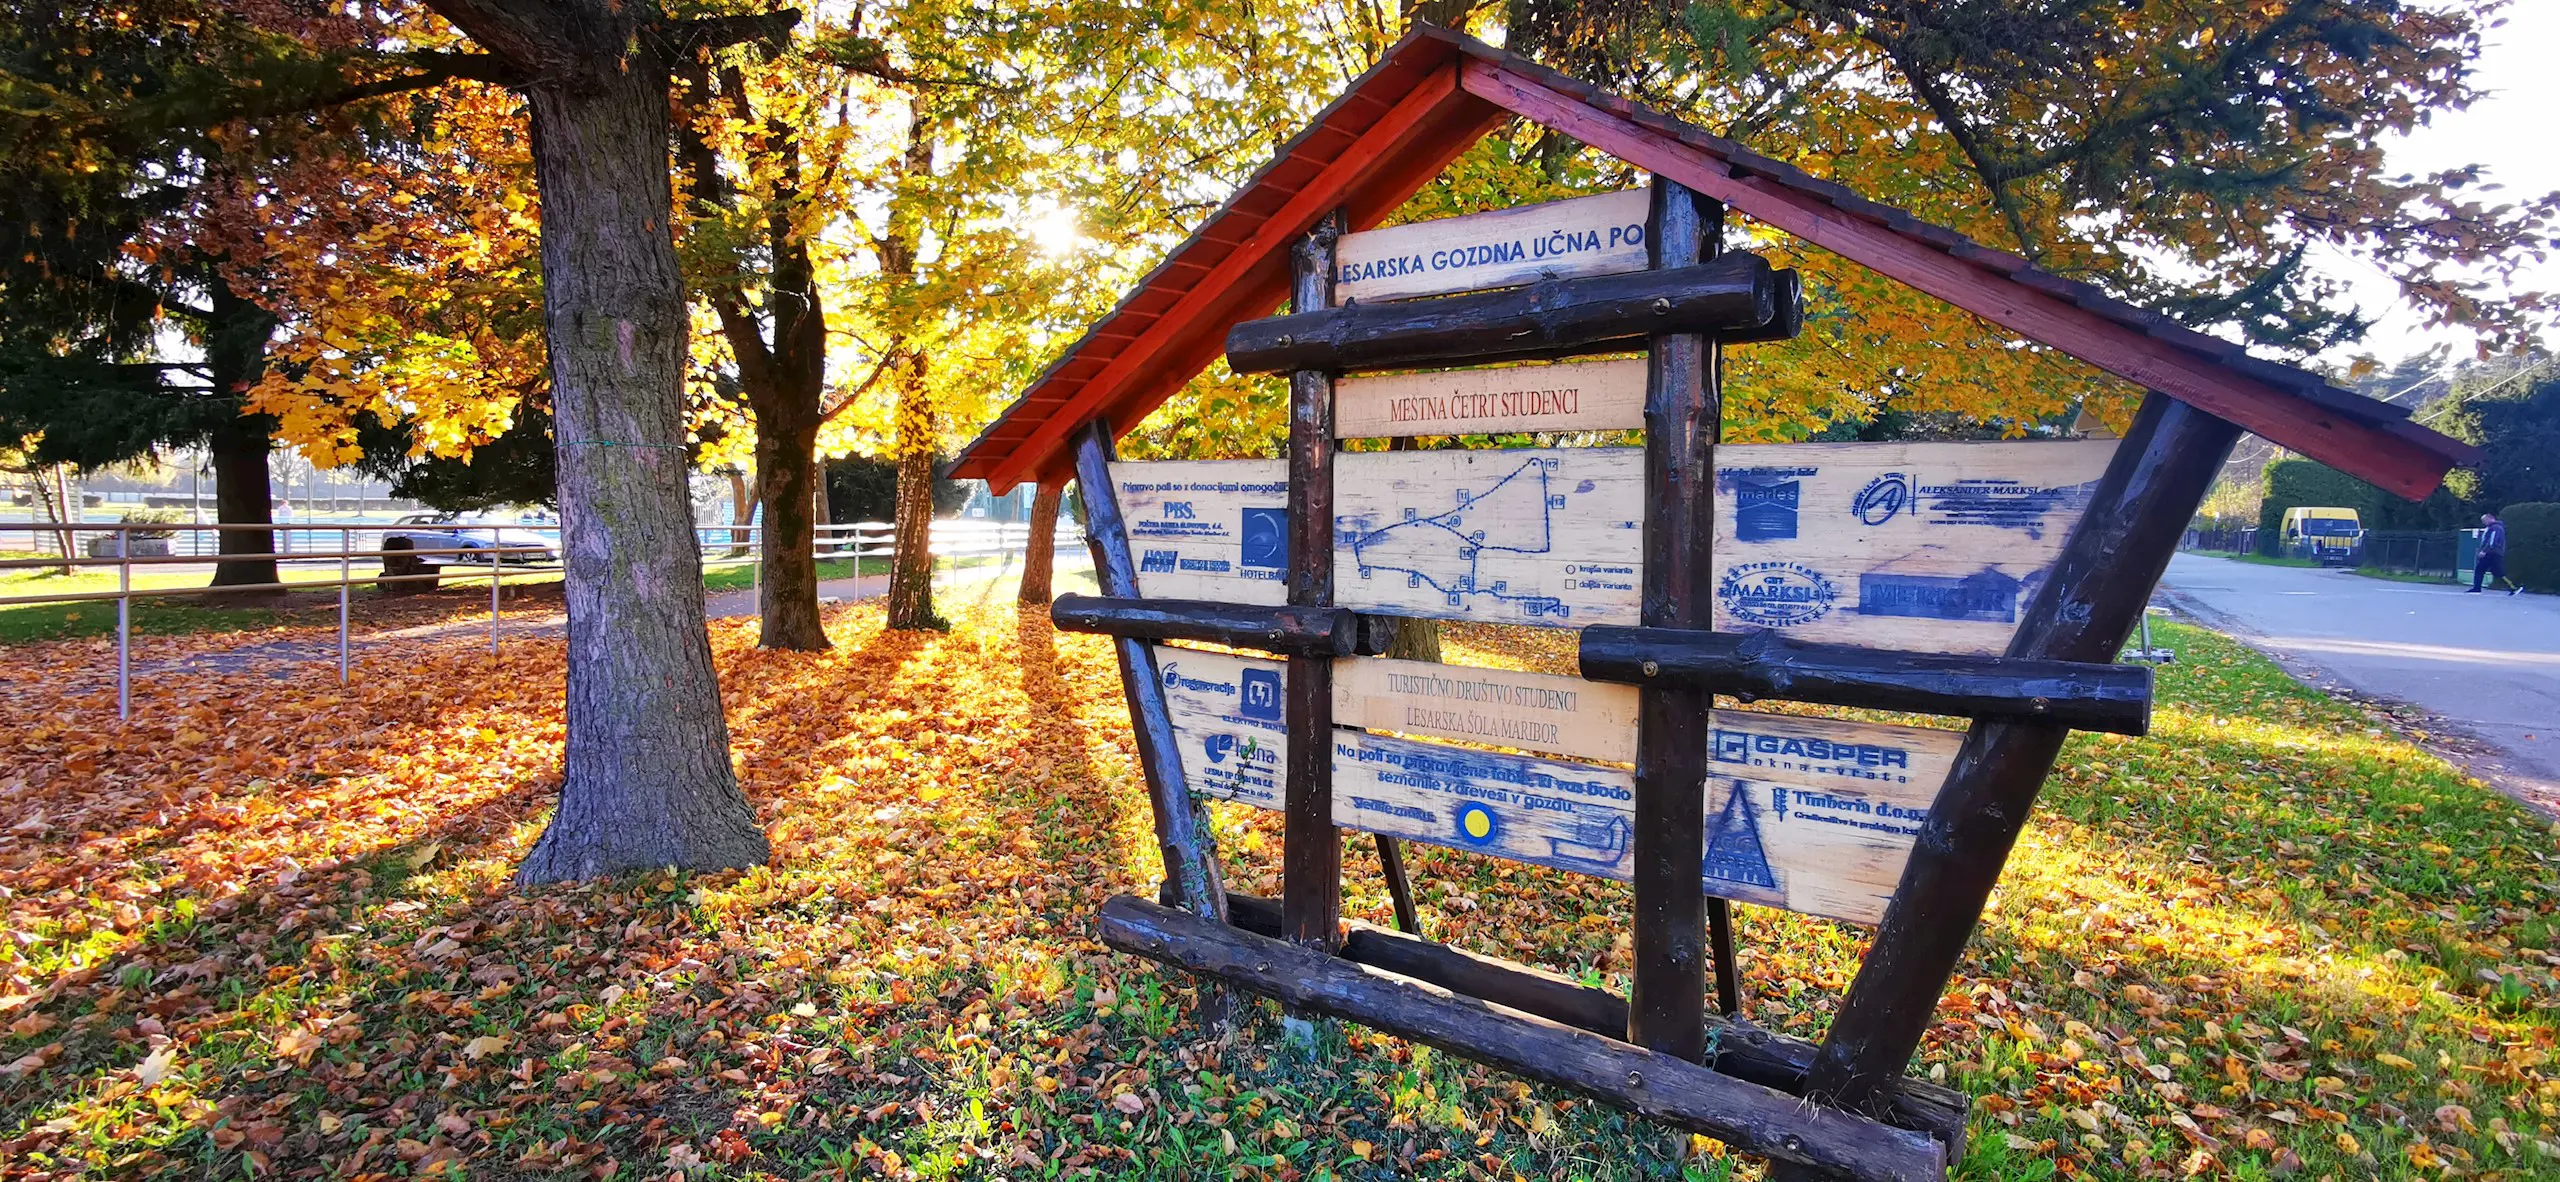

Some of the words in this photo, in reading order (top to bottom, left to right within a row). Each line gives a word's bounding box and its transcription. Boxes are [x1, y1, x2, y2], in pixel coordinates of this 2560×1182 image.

[1335, 256, 1425, 285] LESARSKA
[1431, 240, 1525, 272] GOZDNA
[1533, 229, 1601, 259] UČNA
[1390, 396, 1449, 422] MESTNA
[1451, 388, 1498, 419] ČETRT
[1501, 387, 1579, 417] STUDENCI
[1467, 456, 1474, 465] S
[1173, 483, 1183, 491] so
[1190, 481, 1239, 494] donacijami
[1740, 489, 1797, 500] marles
[1240, 569, 1268, 580] HOTEL
[1603, 566, 1633, 575] varianta
[1603, 583, 1633, 591] varianta
[1732, 583, 1815, 601] MARKSL
[1387, 672, 1454, 698] TURISTIČNO
[1456, 677, 1513, 703] DRUŠTVO
[1515, 686, 1578, 713] STUDENCI
[1406, 706, 1466, 733] LESARSKA
[1467, 709, 1498, 738] ŠOLA
[1501, 718, 1560, 745] MARIBOR
[1337, 743, 1355, 757] Na
[1358, 748, 1383, 762] poti
[1386, 752, 1401, 764] so
[1402, 756, 1488, 779] pripravljene
[1556, 780, 1584, 794] vas
[1585, 781, 1632, 801] bodo
[1754, 757, 1810, 773] okna
[1444, 782, 1452, 793] z
[1455, 782, 1508, 803] drevesi
[1511, 793, 1520, 804] v
[1792, 790, 1871, 815] Timberia
